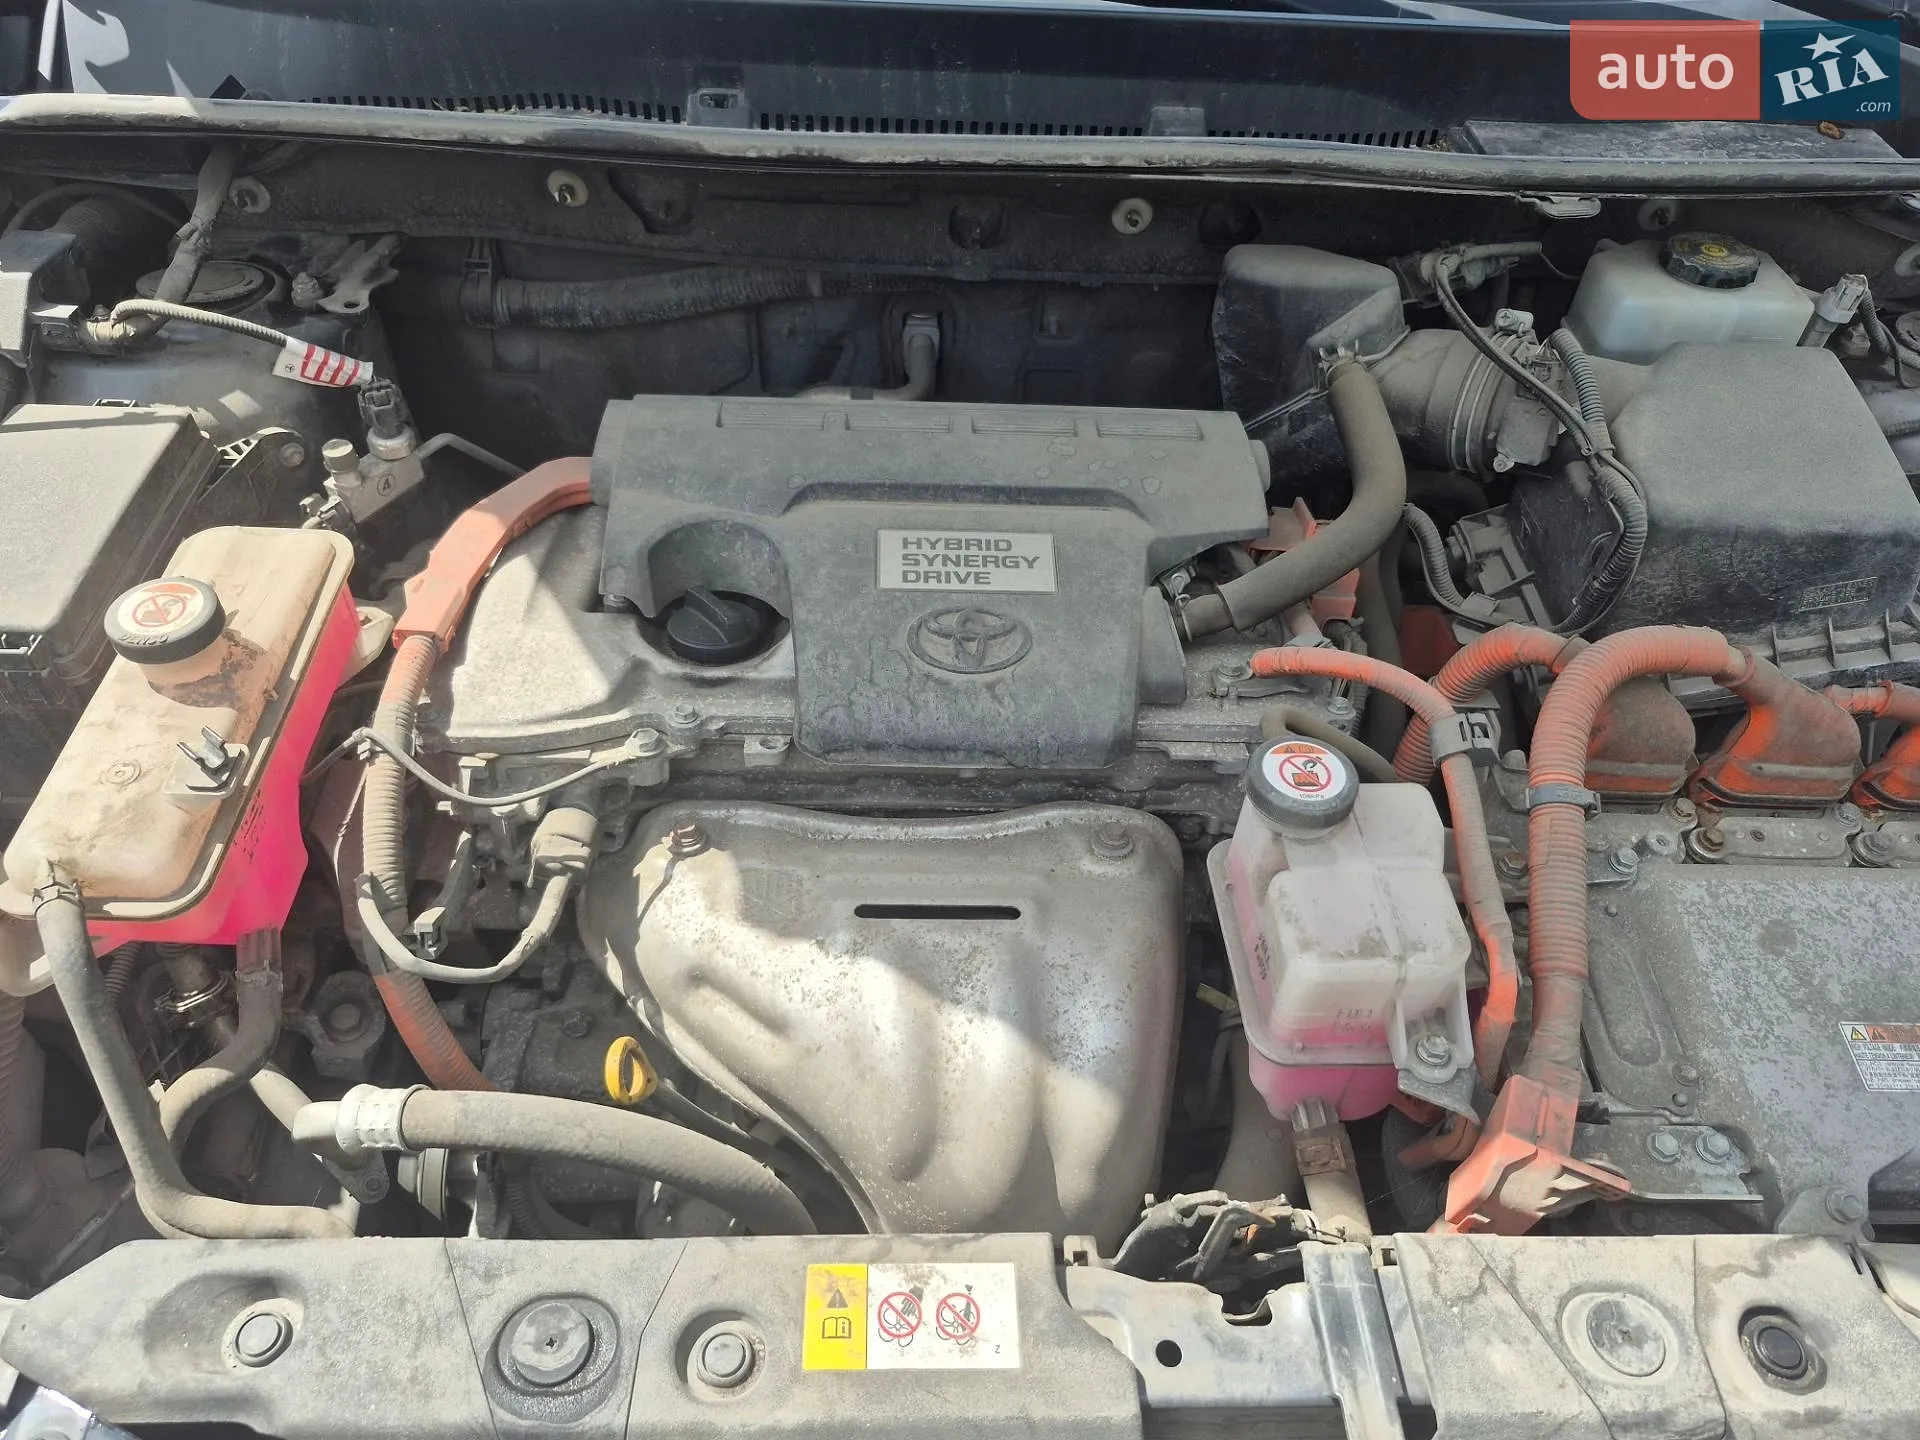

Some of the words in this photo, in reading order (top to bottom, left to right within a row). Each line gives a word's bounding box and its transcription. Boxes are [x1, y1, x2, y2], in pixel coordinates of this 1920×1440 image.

[902, 537, 1012, 551] HYBRID
[902, 554, 1040, 569] SYNERGY
[902, 570, 992, 585] DRIVE
